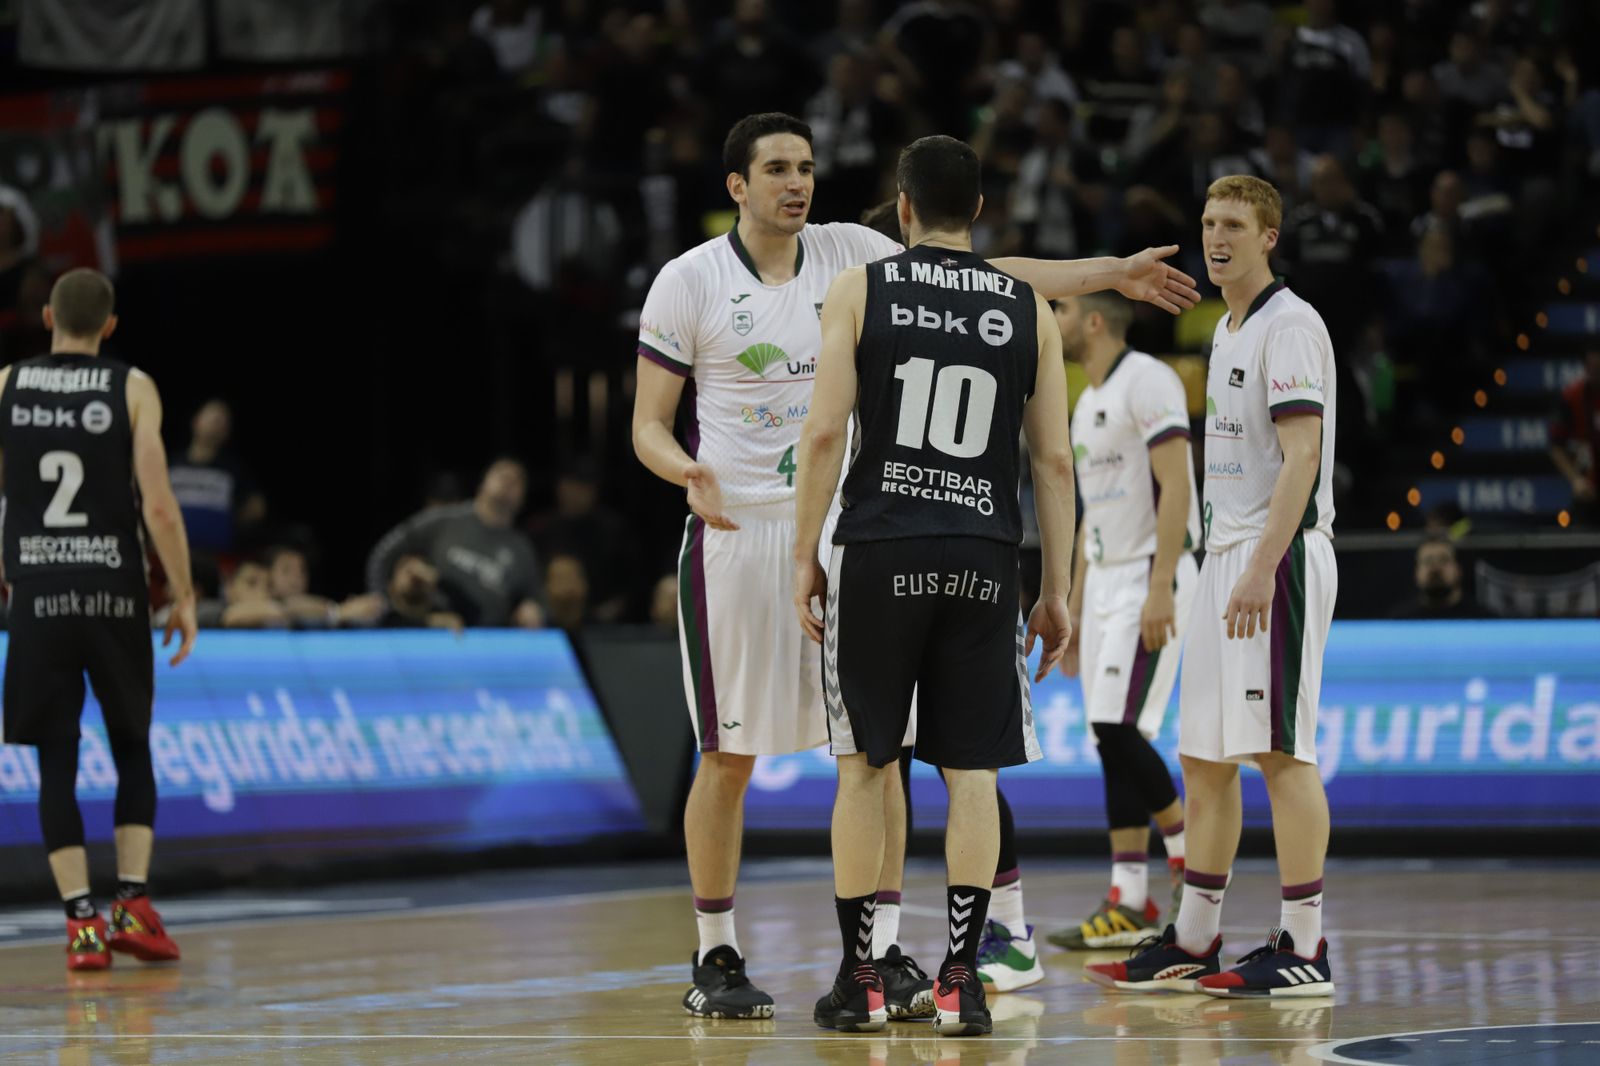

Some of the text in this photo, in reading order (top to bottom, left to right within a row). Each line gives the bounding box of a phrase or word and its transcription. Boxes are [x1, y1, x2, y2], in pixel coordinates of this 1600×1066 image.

[884, 262, 906, 283] R.
[891, 303, 969, 335] bbk
[12, 404, 77, 428] bbk
[894, 356, 998, 459] 10
[39, 450, 88, 528] 2
[883, 461, 992, 497] BEOTIBAR
[150, 686, 378, 812] eguridad
